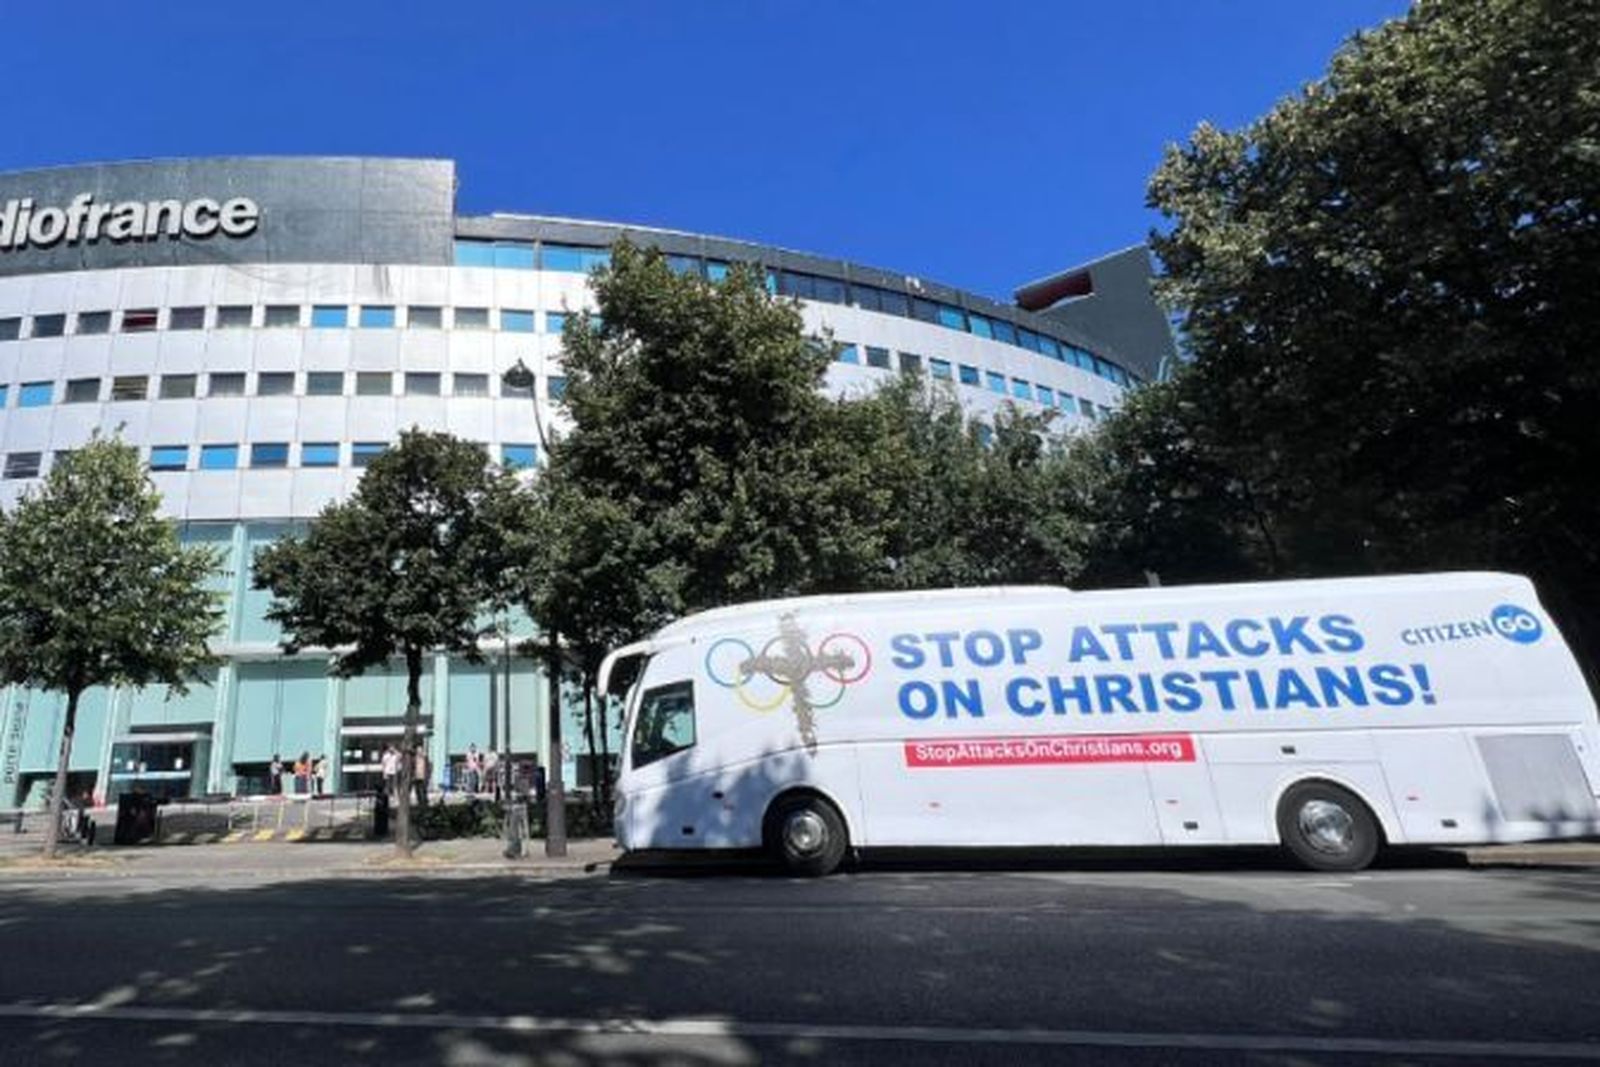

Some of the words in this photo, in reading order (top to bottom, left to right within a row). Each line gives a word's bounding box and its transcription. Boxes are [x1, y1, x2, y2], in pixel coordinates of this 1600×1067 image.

[891, 630, 1042, 669] STOP
[1067, 614, 1365, 663] ATTACKS
[897, 679, 984, 720] ON
[1005, 663, 1437, 717] CHRISTIANS!
[915, 740, 1182, 763] StopAttacksOnChristians.org
